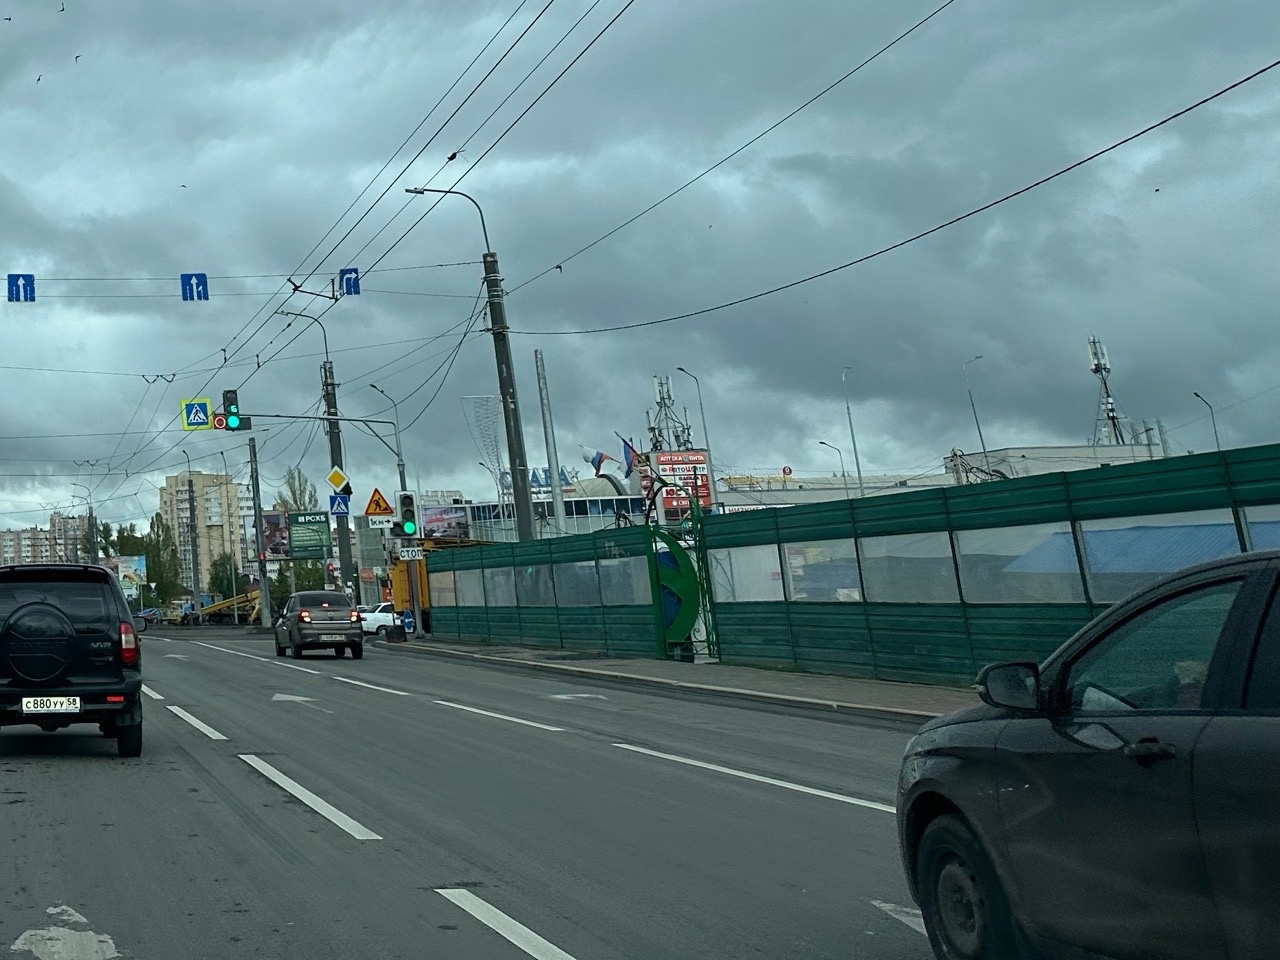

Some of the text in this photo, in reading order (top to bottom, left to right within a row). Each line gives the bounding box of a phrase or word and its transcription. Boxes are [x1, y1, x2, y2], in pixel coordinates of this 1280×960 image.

[305, 515, 326, 523] РСХБ
[400, 550, 422, 559] СТОП
[67, 698, 77, 706] 58
